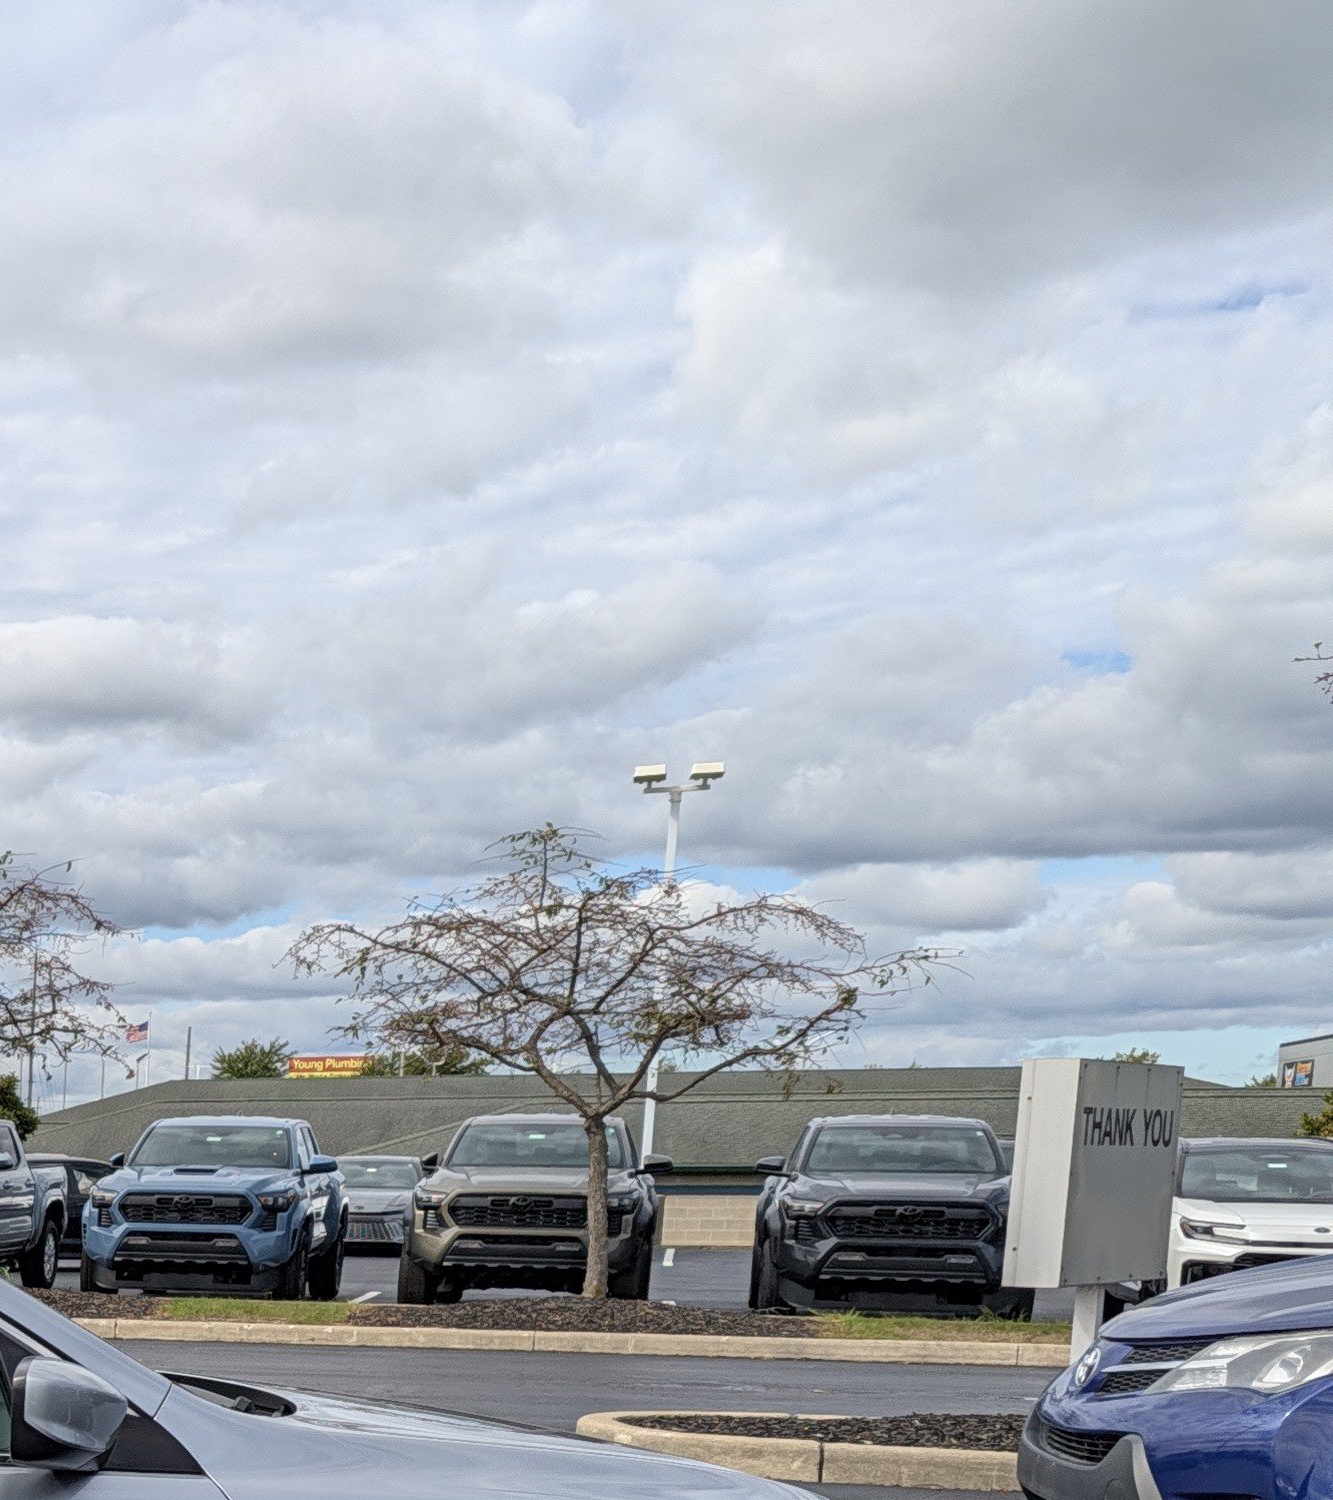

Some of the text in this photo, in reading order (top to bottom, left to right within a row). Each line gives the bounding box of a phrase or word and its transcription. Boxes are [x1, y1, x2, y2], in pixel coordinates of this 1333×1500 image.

[292, 1058, 323, 1071] Young
[1083, 1106, 1174, 1148] THANK YOU
